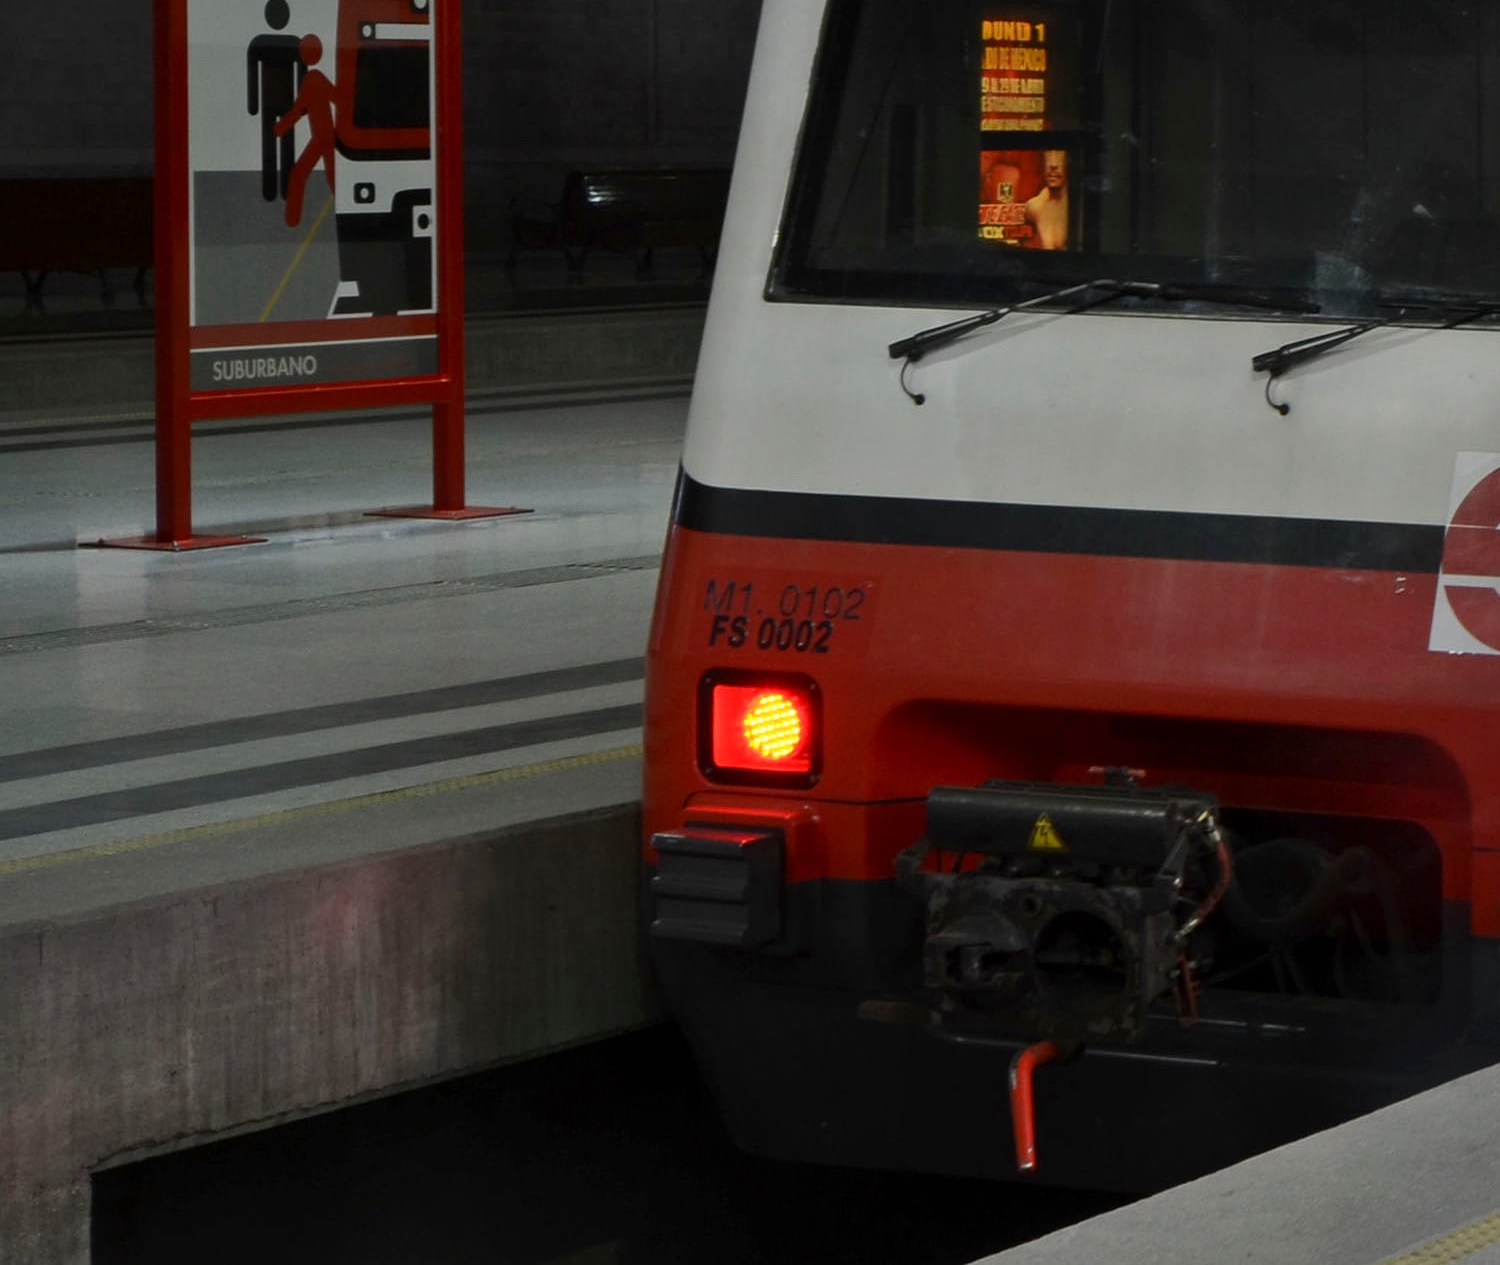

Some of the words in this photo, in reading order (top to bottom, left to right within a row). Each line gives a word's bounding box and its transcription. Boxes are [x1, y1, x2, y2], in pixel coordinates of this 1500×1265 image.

[212, 355, 318, 381] SUBURBANO
[779, 584, 866, 621] 0102
[708, 614, 750, 648] FS
[758, 617, 835, 653] 0002
